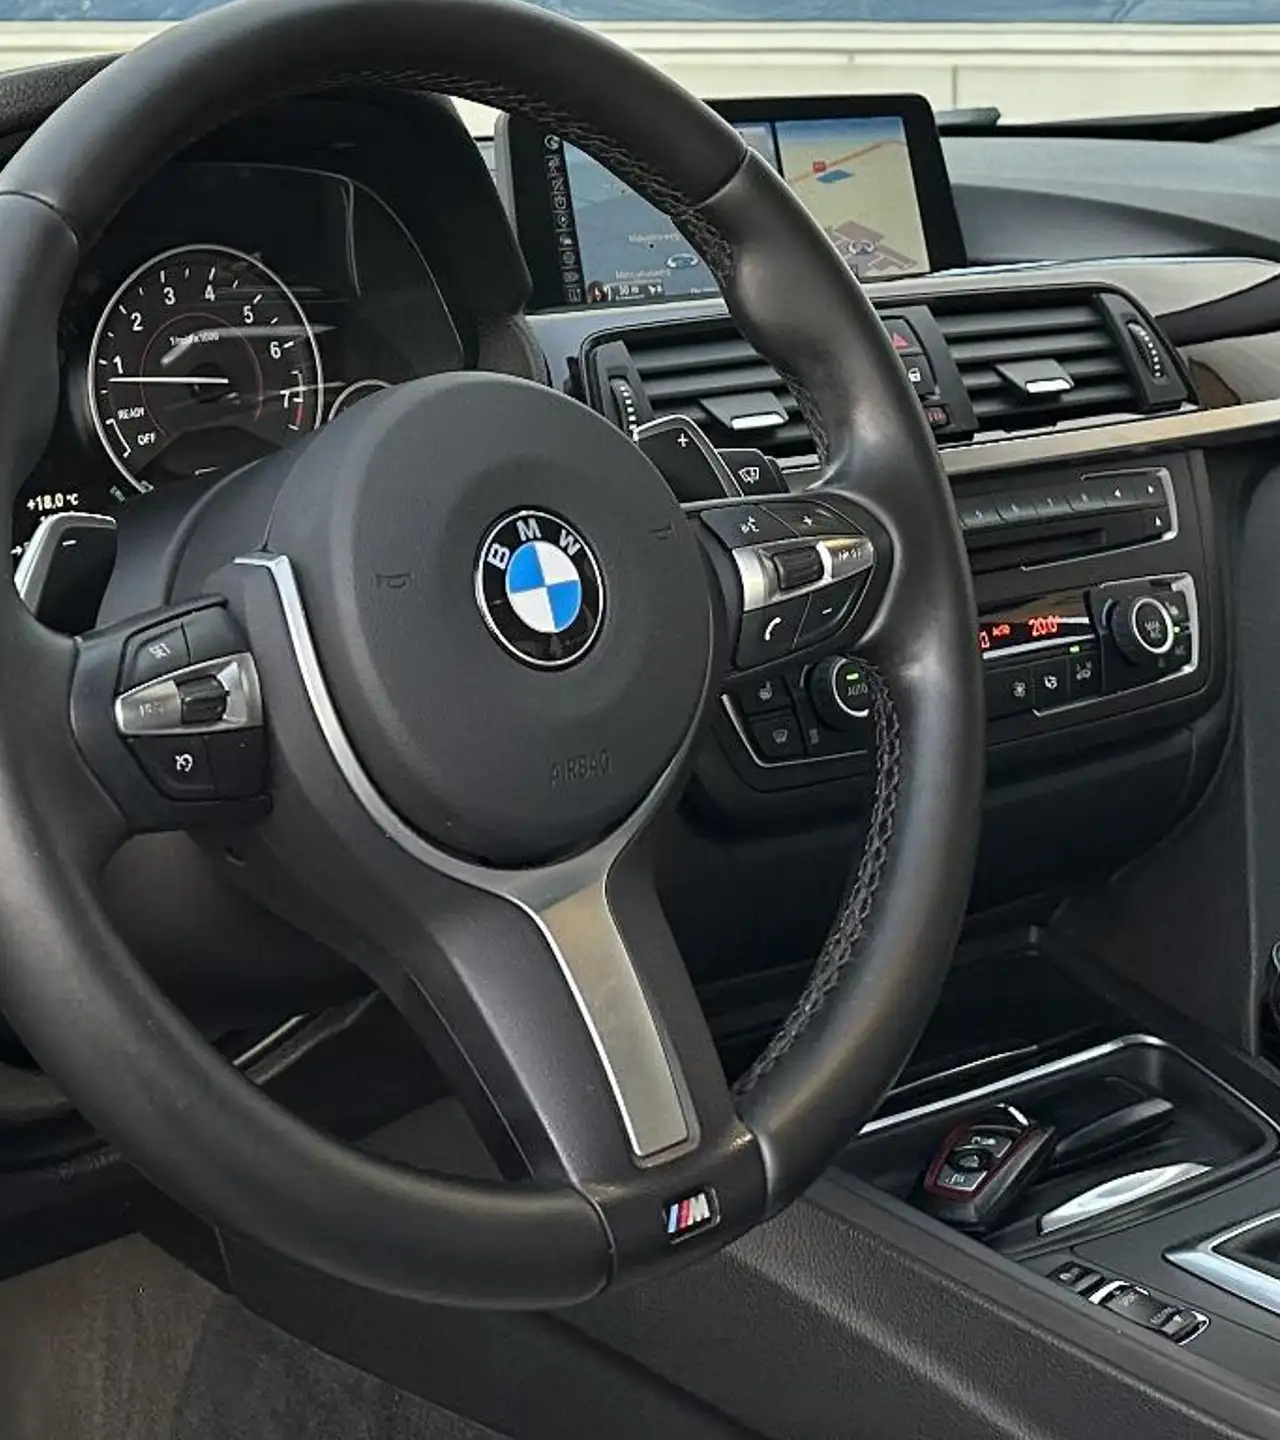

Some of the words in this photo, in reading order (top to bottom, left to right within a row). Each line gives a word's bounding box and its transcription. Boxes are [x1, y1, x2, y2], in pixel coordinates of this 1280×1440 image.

[164, 287, 176, 305] 3
[205, 285, 216, 302] 4
[131, 312, 144, 331] 2
[243, 306, 254, 324] 5
[270, 341, 282, 359] 6
[113, 356, 124, 374] 1
[280, 389, 290, 408] 7
[138, 433, 157, 446] OFF
[487, 517, 583, 571] BMW
